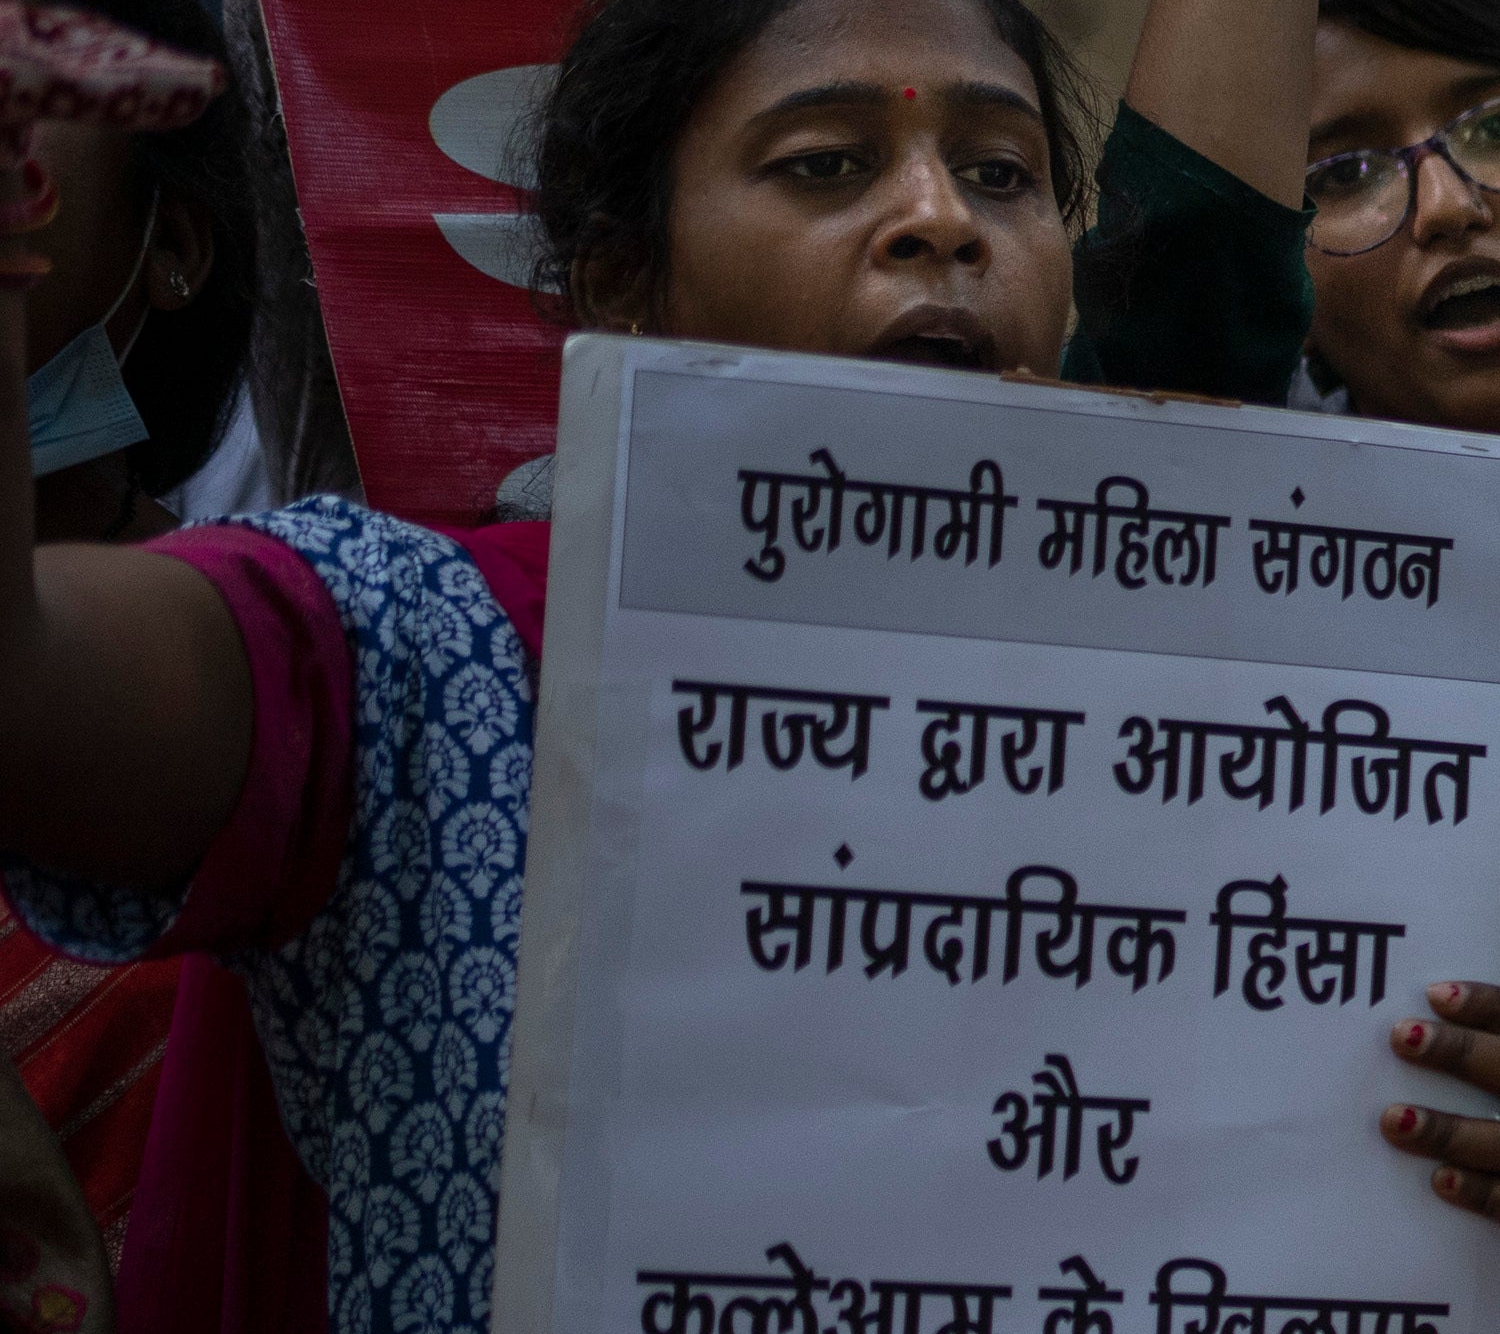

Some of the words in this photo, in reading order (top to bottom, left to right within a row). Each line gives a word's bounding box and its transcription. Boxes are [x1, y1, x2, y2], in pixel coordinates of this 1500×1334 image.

[738, 448, 1017, 582] पुरोगामी
[1038, 474, 1230, 589] महिला
[1250, 488, 1453, 608] संगठन
[673, 678, 889, 778] राज्य
[917, 699, 1085, 802] द्वारा
[1114, 695, 1486, 825] आयोजित
[741, 844, 1186, 994] सांप्रदायिक
[1209, 872, 1404, 1011] हिंसा
[986, 1053, 1149, 1186] और
